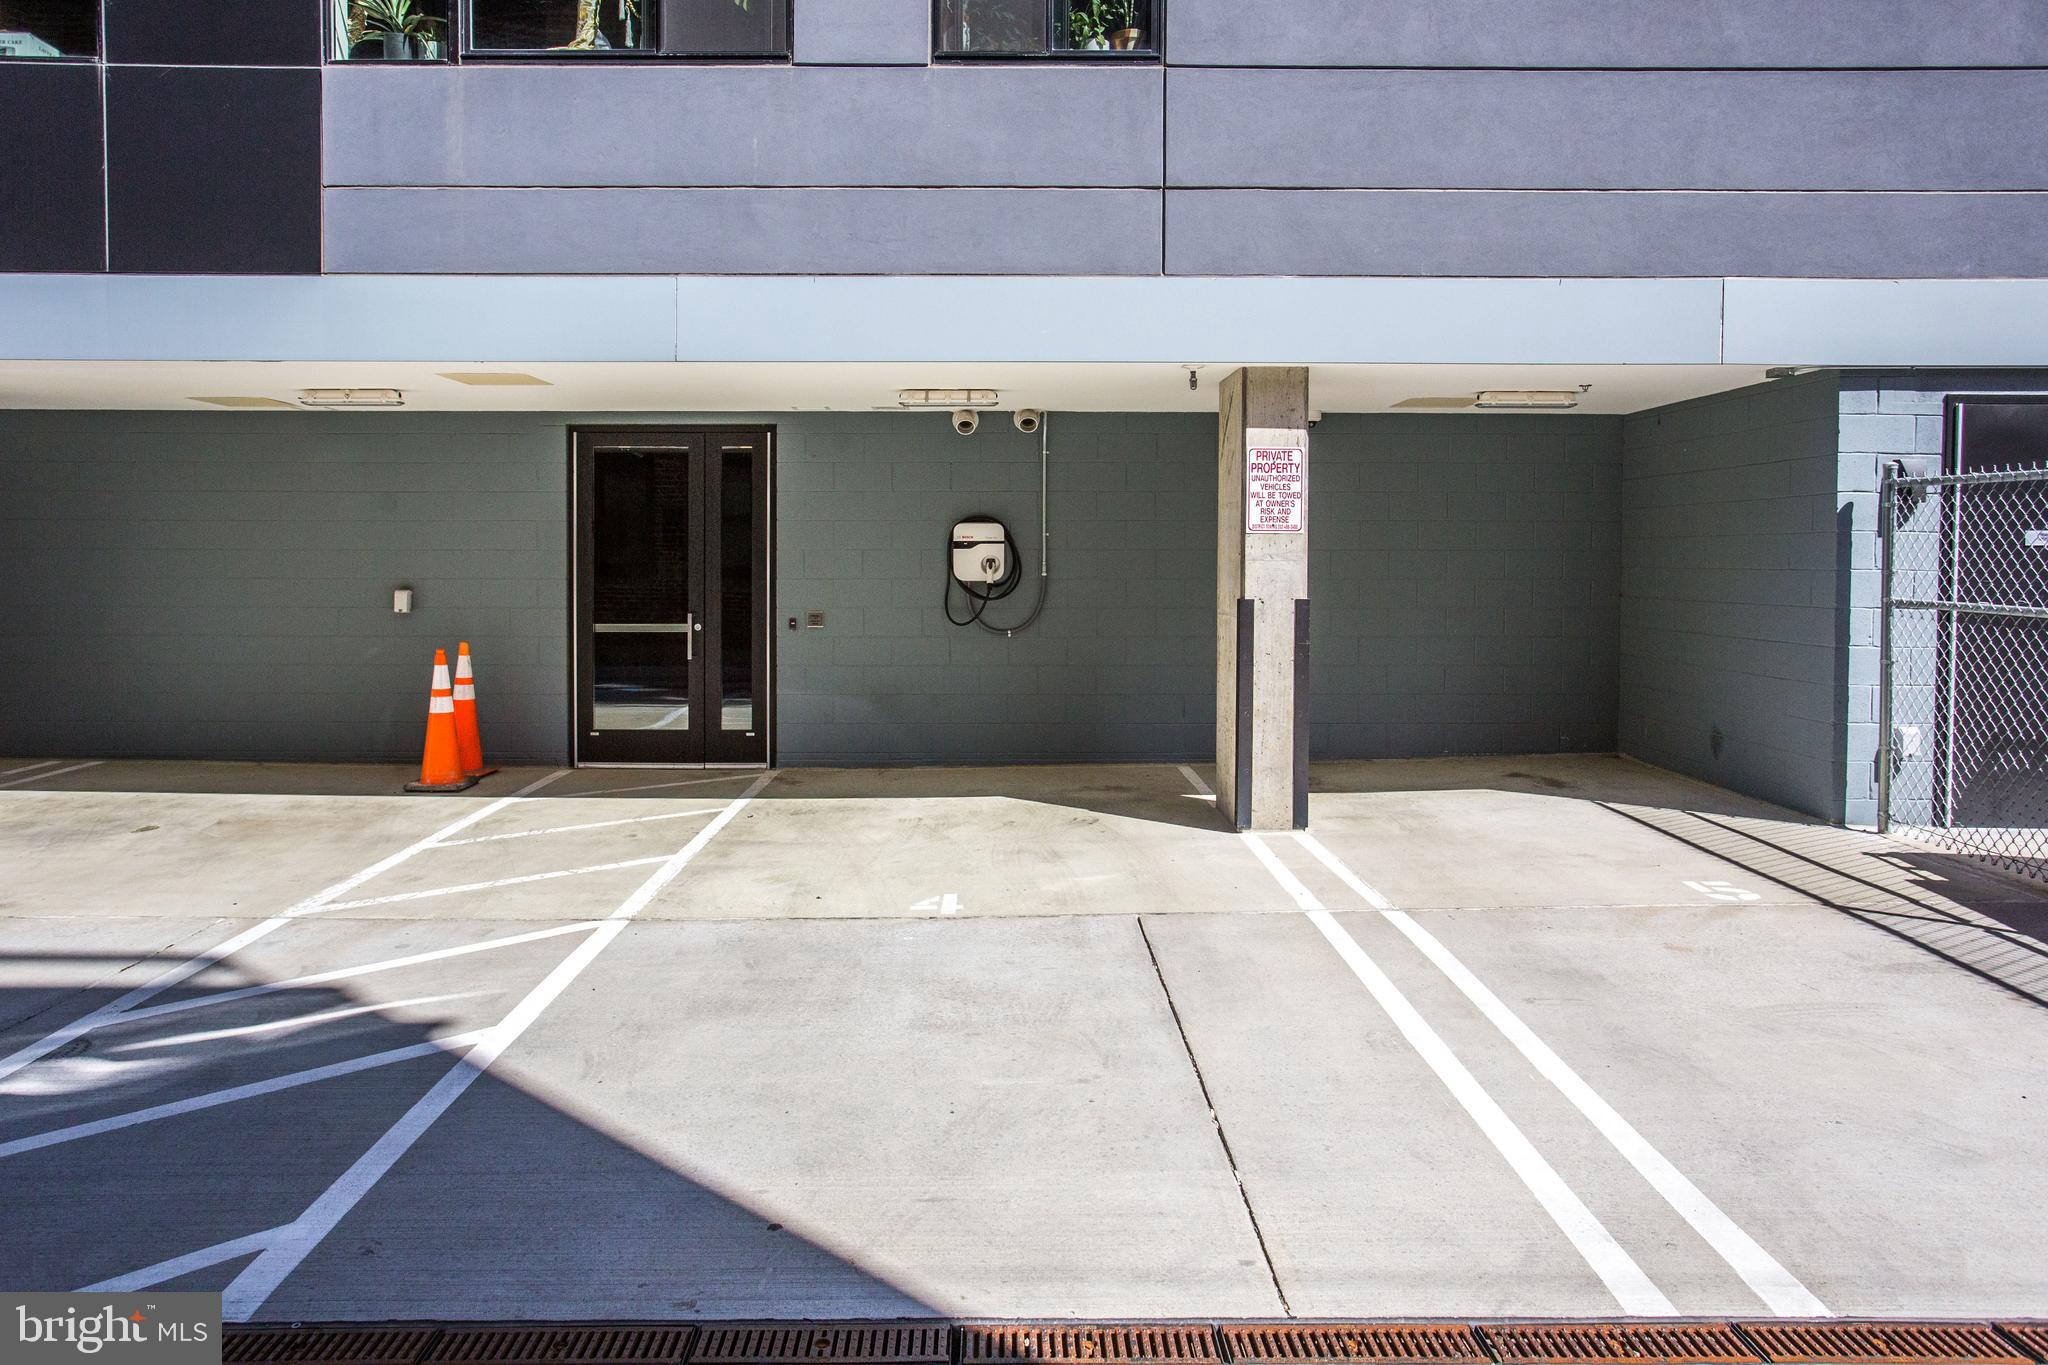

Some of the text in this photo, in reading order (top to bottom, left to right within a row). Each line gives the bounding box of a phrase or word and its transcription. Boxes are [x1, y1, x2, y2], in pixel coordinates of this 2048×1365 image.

[1256, 450, 1293, 461] PRIVATE
[1251, 463, 1300, 473] PROPERTY
[1681, 881, 1761, 900] 5
[910, 893, 964, 914] 4
